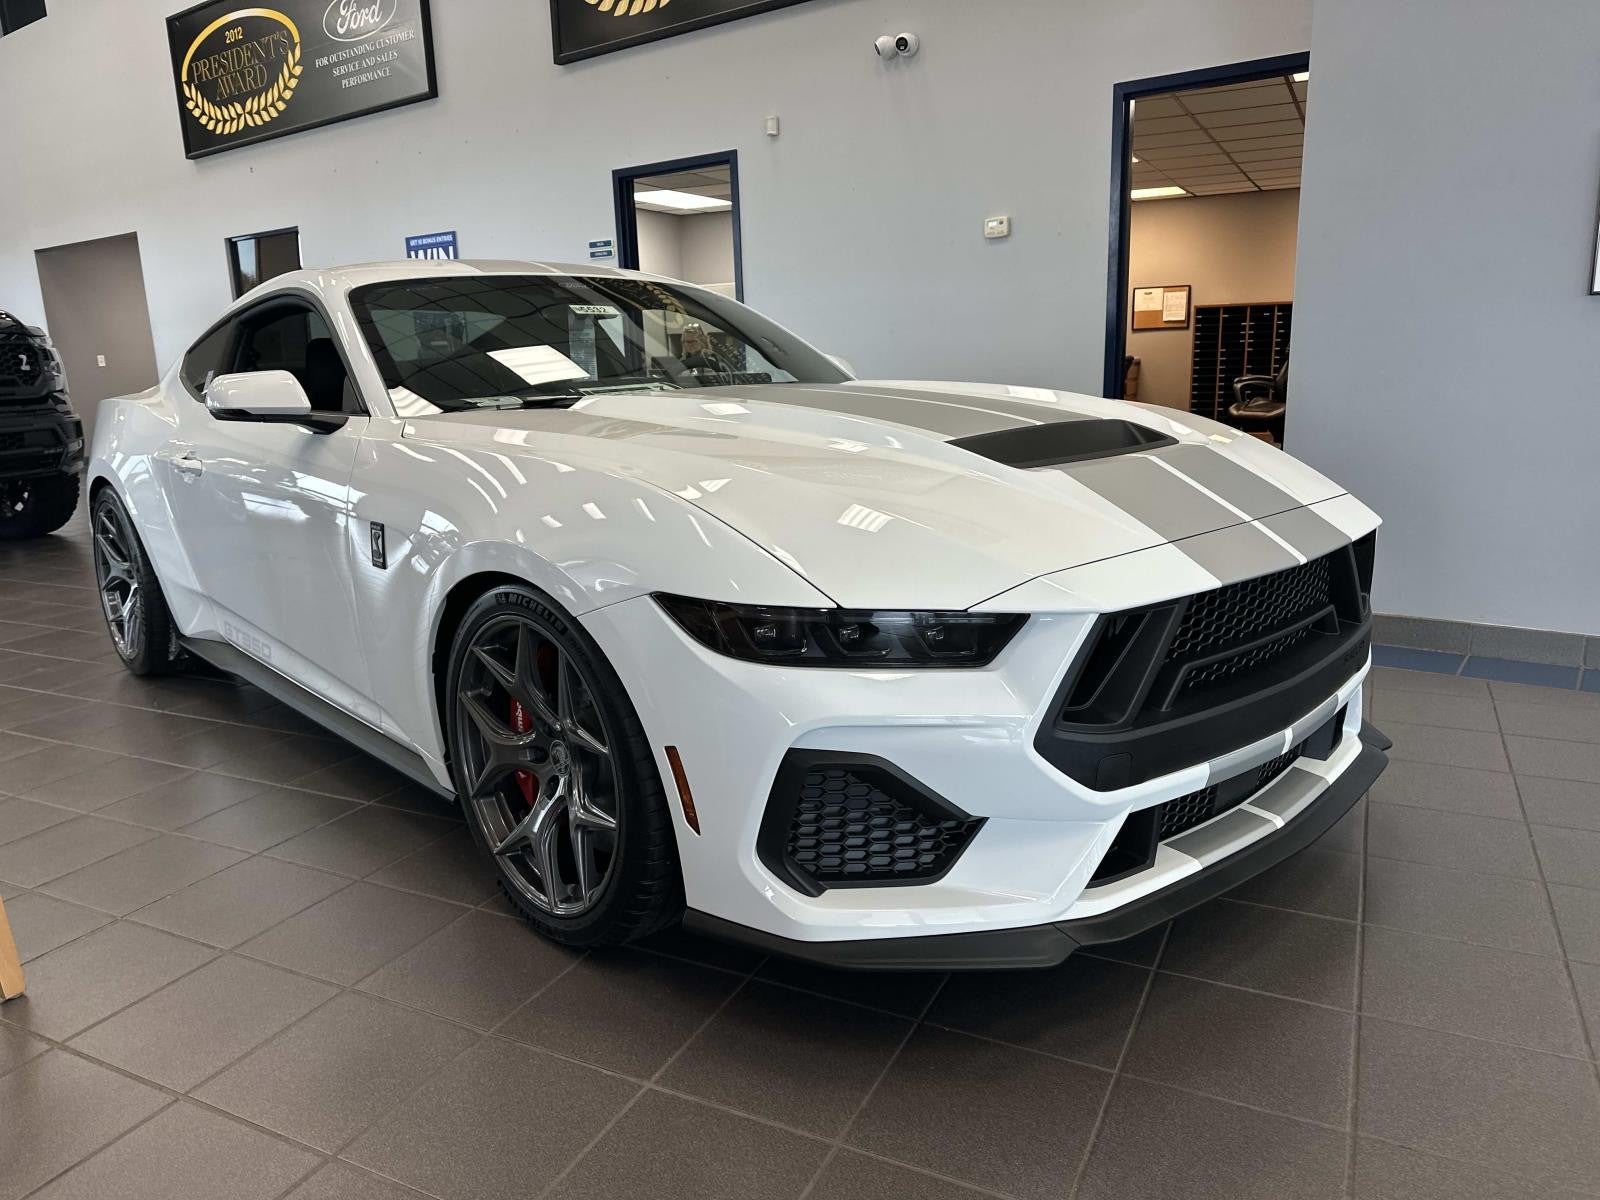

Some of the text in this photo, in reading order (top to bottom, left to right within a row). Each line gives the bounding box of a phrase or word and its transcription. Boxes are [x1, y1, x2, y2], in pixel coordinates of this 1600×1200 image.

[225, 27, 244, 44] 2012
[315, 31, 415, 68] FOR OUTSTANDING CUSTOMER
[191, 30, 292, 84] PRESIDENT'S
[332, 51, 398, 77] SERVICE AND SALES
[215, 64, 268, 100] AWARD
[341, 67, 392, 88] PERFORMANCE
[410, 245, 454, 260] WIN
[508, 593, 565, 631] MICHELIN
